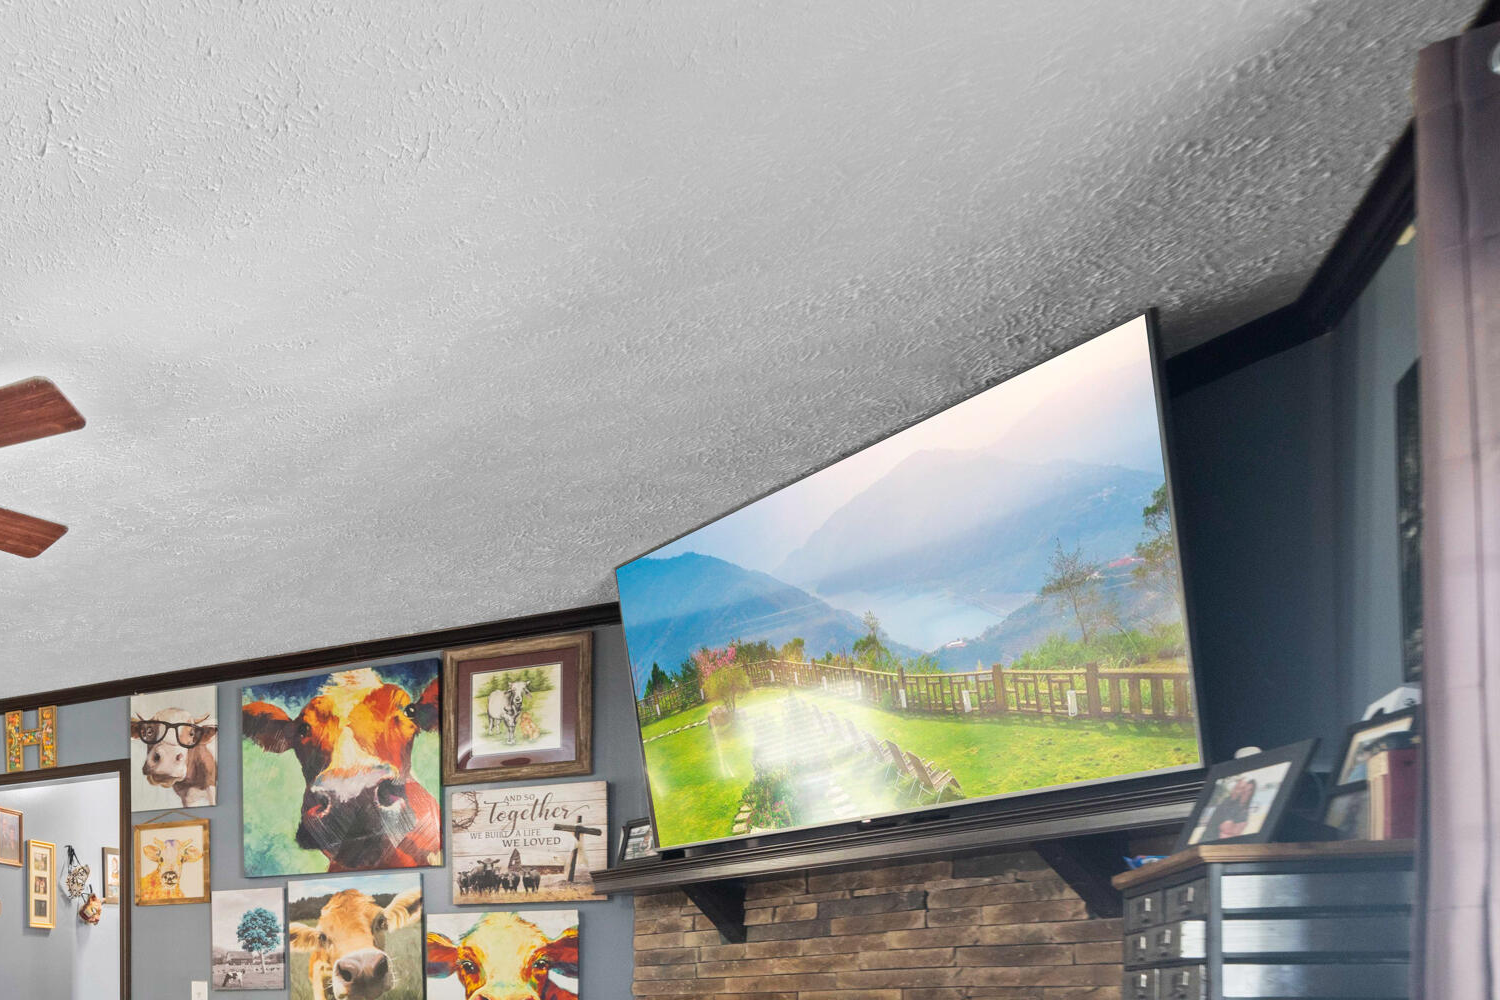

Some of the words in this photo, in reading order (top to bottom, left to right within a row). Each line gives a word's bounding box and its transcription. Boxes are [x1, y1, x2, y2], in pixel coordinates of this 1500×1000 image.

[5, 705, 57, 773] H
[504, 794, 521, 802] AND
[524, 793, 536, 801] SO
[484, 792, 589, 838] Together
[470, 832, 483, 840] WE
[485, 830, 509, 839] BUILT
[523, 829, 541, 837] LIFE
[502, 839, 520, 848] WE
[523, 836, 561, 847] LOVED
